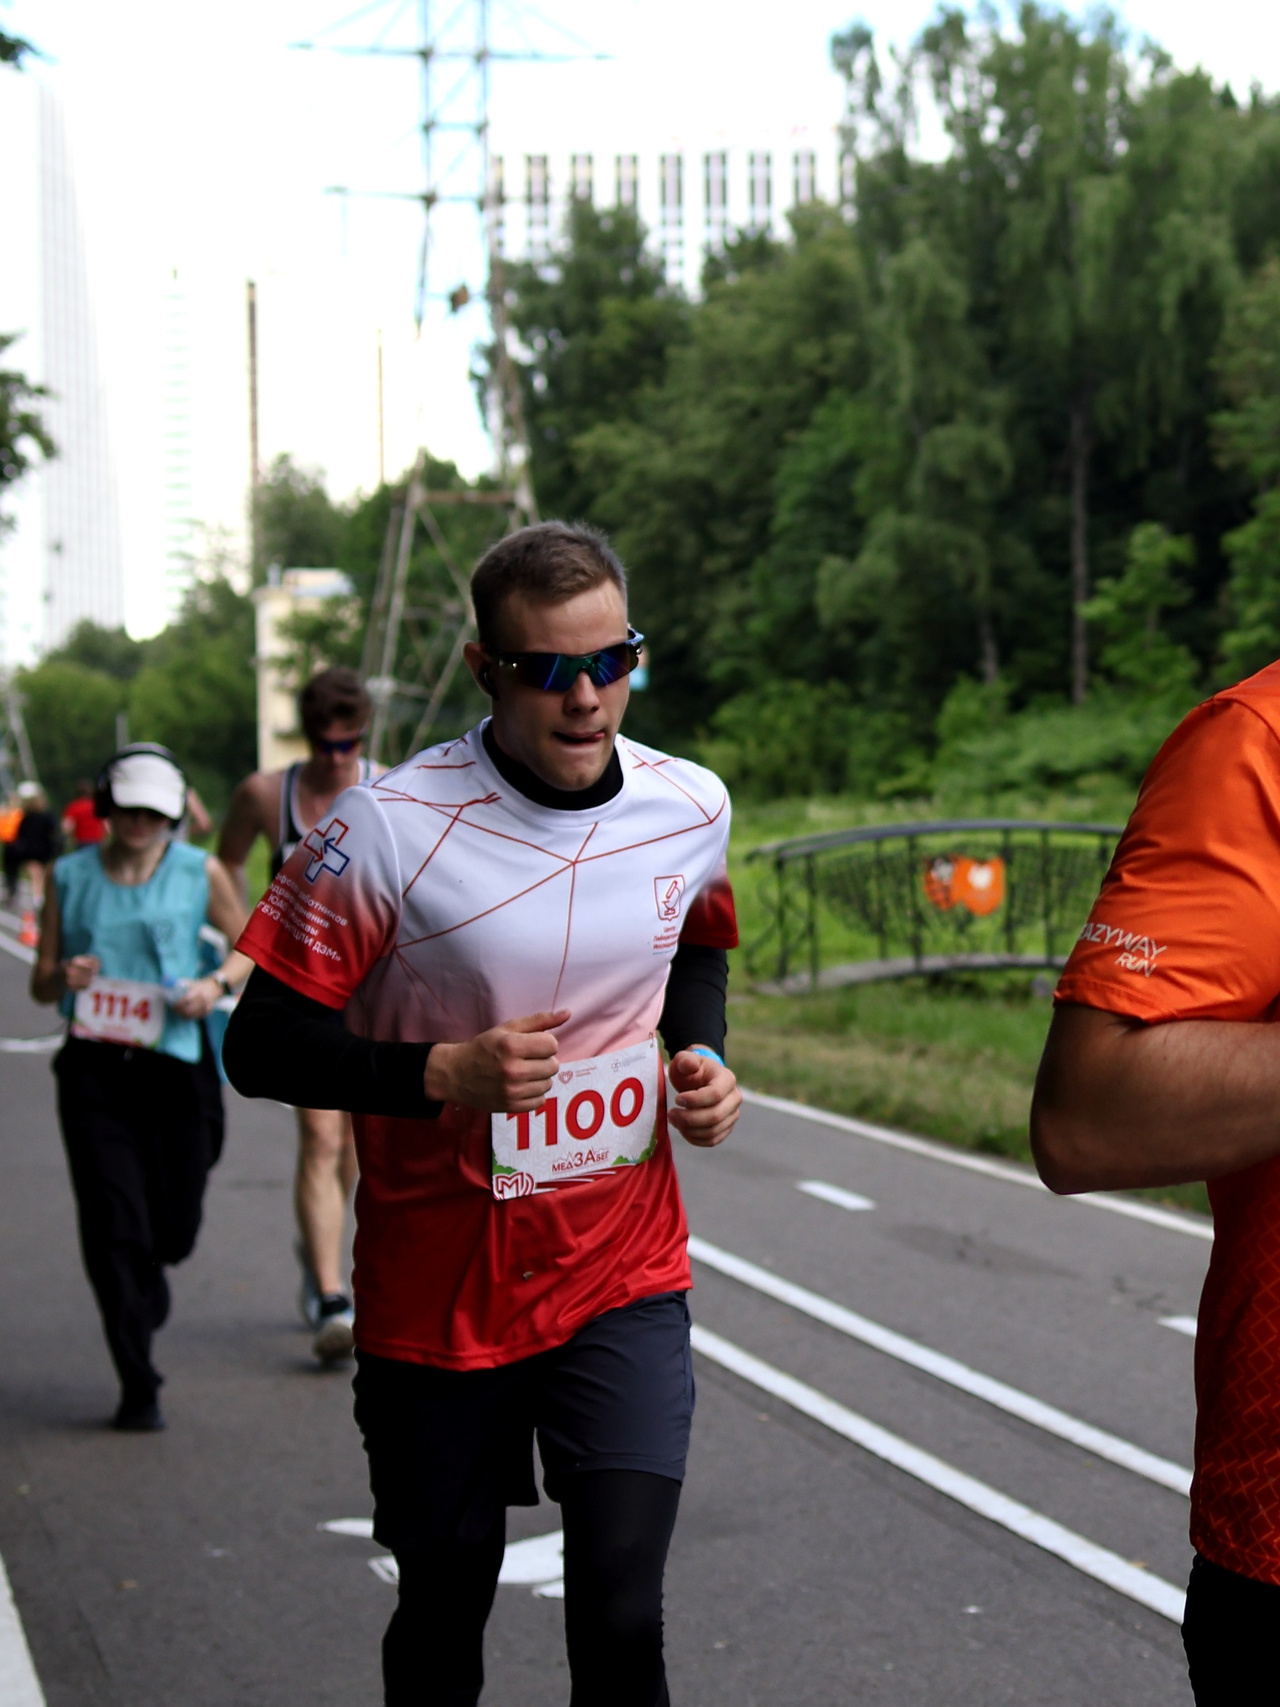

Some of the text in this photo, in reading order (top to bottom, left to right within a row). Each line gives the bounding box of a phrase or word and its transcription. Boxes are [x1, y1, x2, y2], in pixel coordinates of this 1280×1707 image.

[1114, 952, 1158, 978] RUN
[92, 992, 150, 1023] 1114
[506, 1076, 644, 1151] 1100
